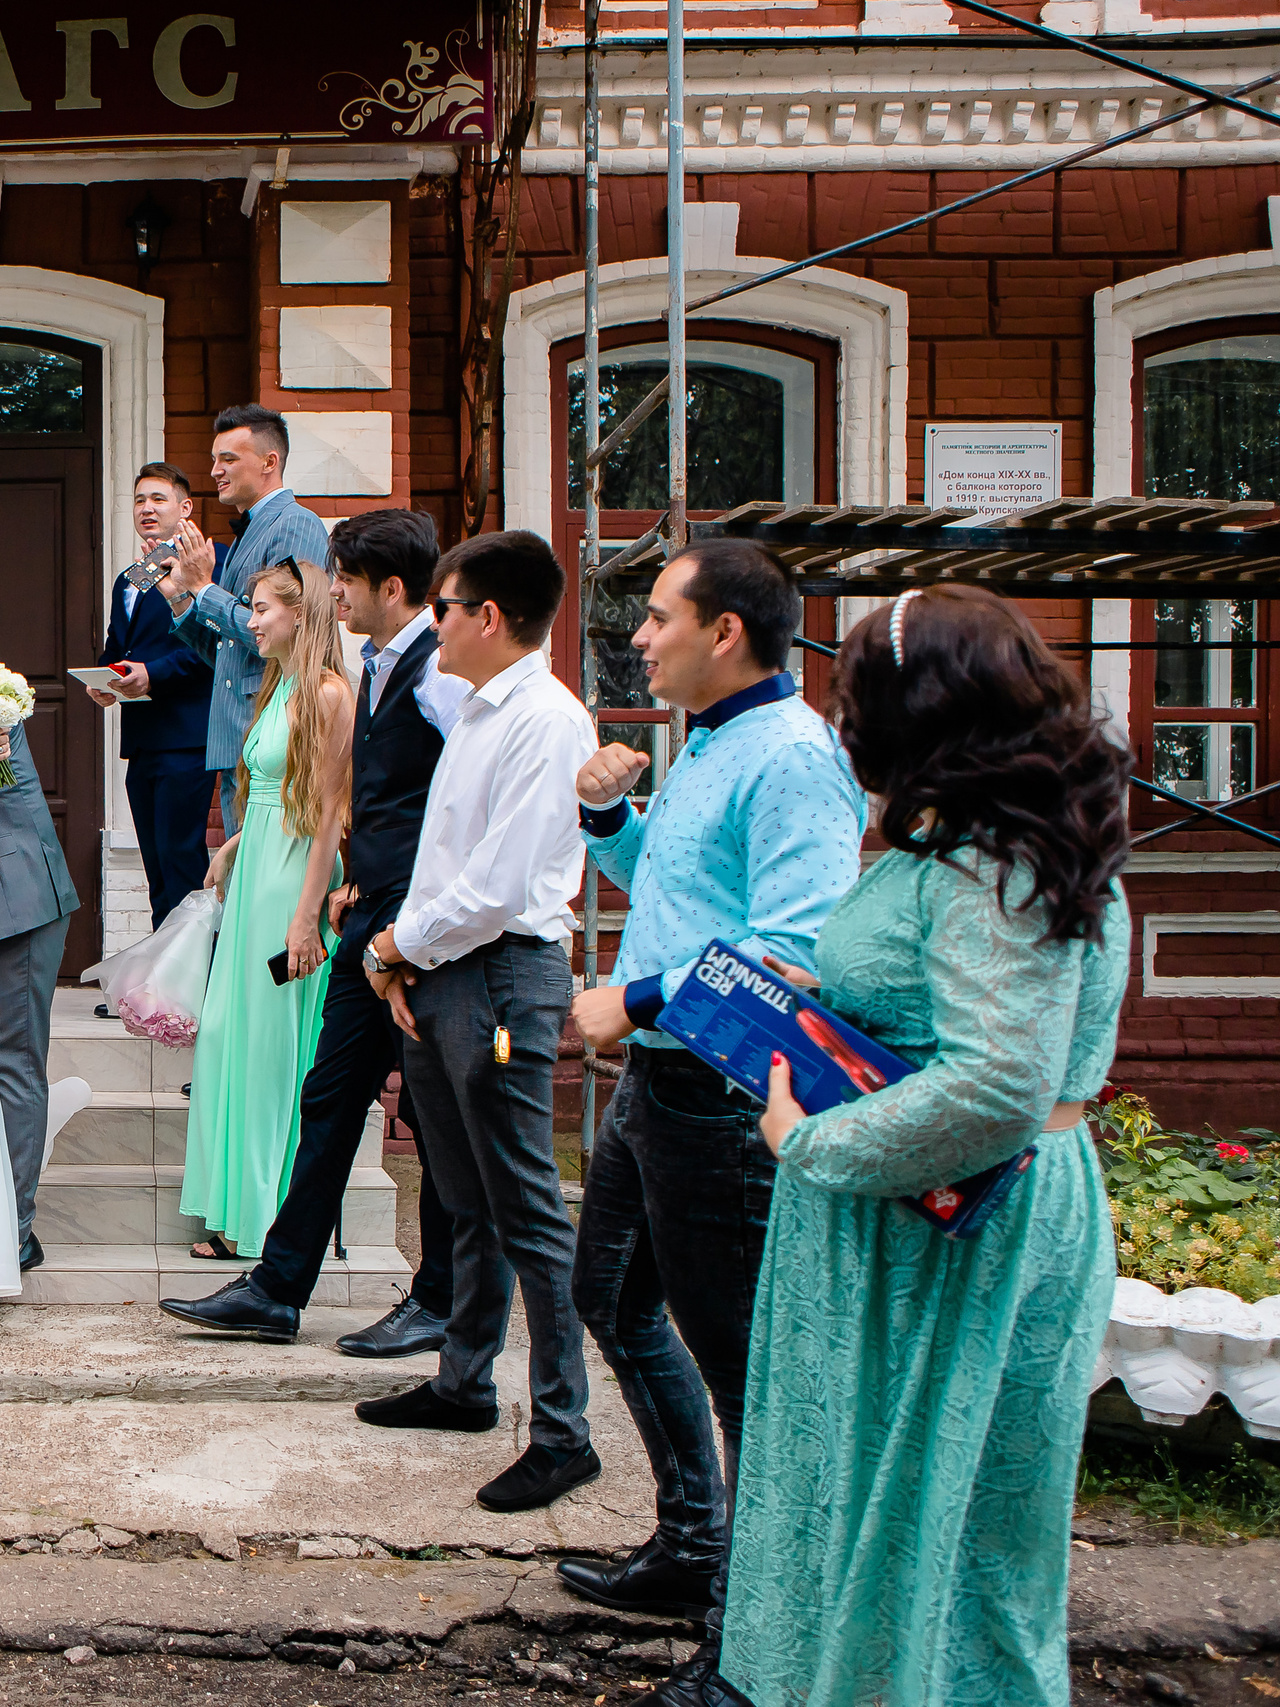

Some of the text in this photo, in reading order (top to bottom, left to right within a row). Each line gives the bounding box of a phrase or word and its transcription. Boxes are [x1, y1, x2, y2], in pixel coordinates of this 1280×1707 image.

[938, 470, 1051, 480] «Дом конца XIX-XX вв.,
[947, 481, 1042, 492] с балкона которого
[946, 494, 1043, 505] в 1919 г. выступала
[695, 963, 737, 997] RED
